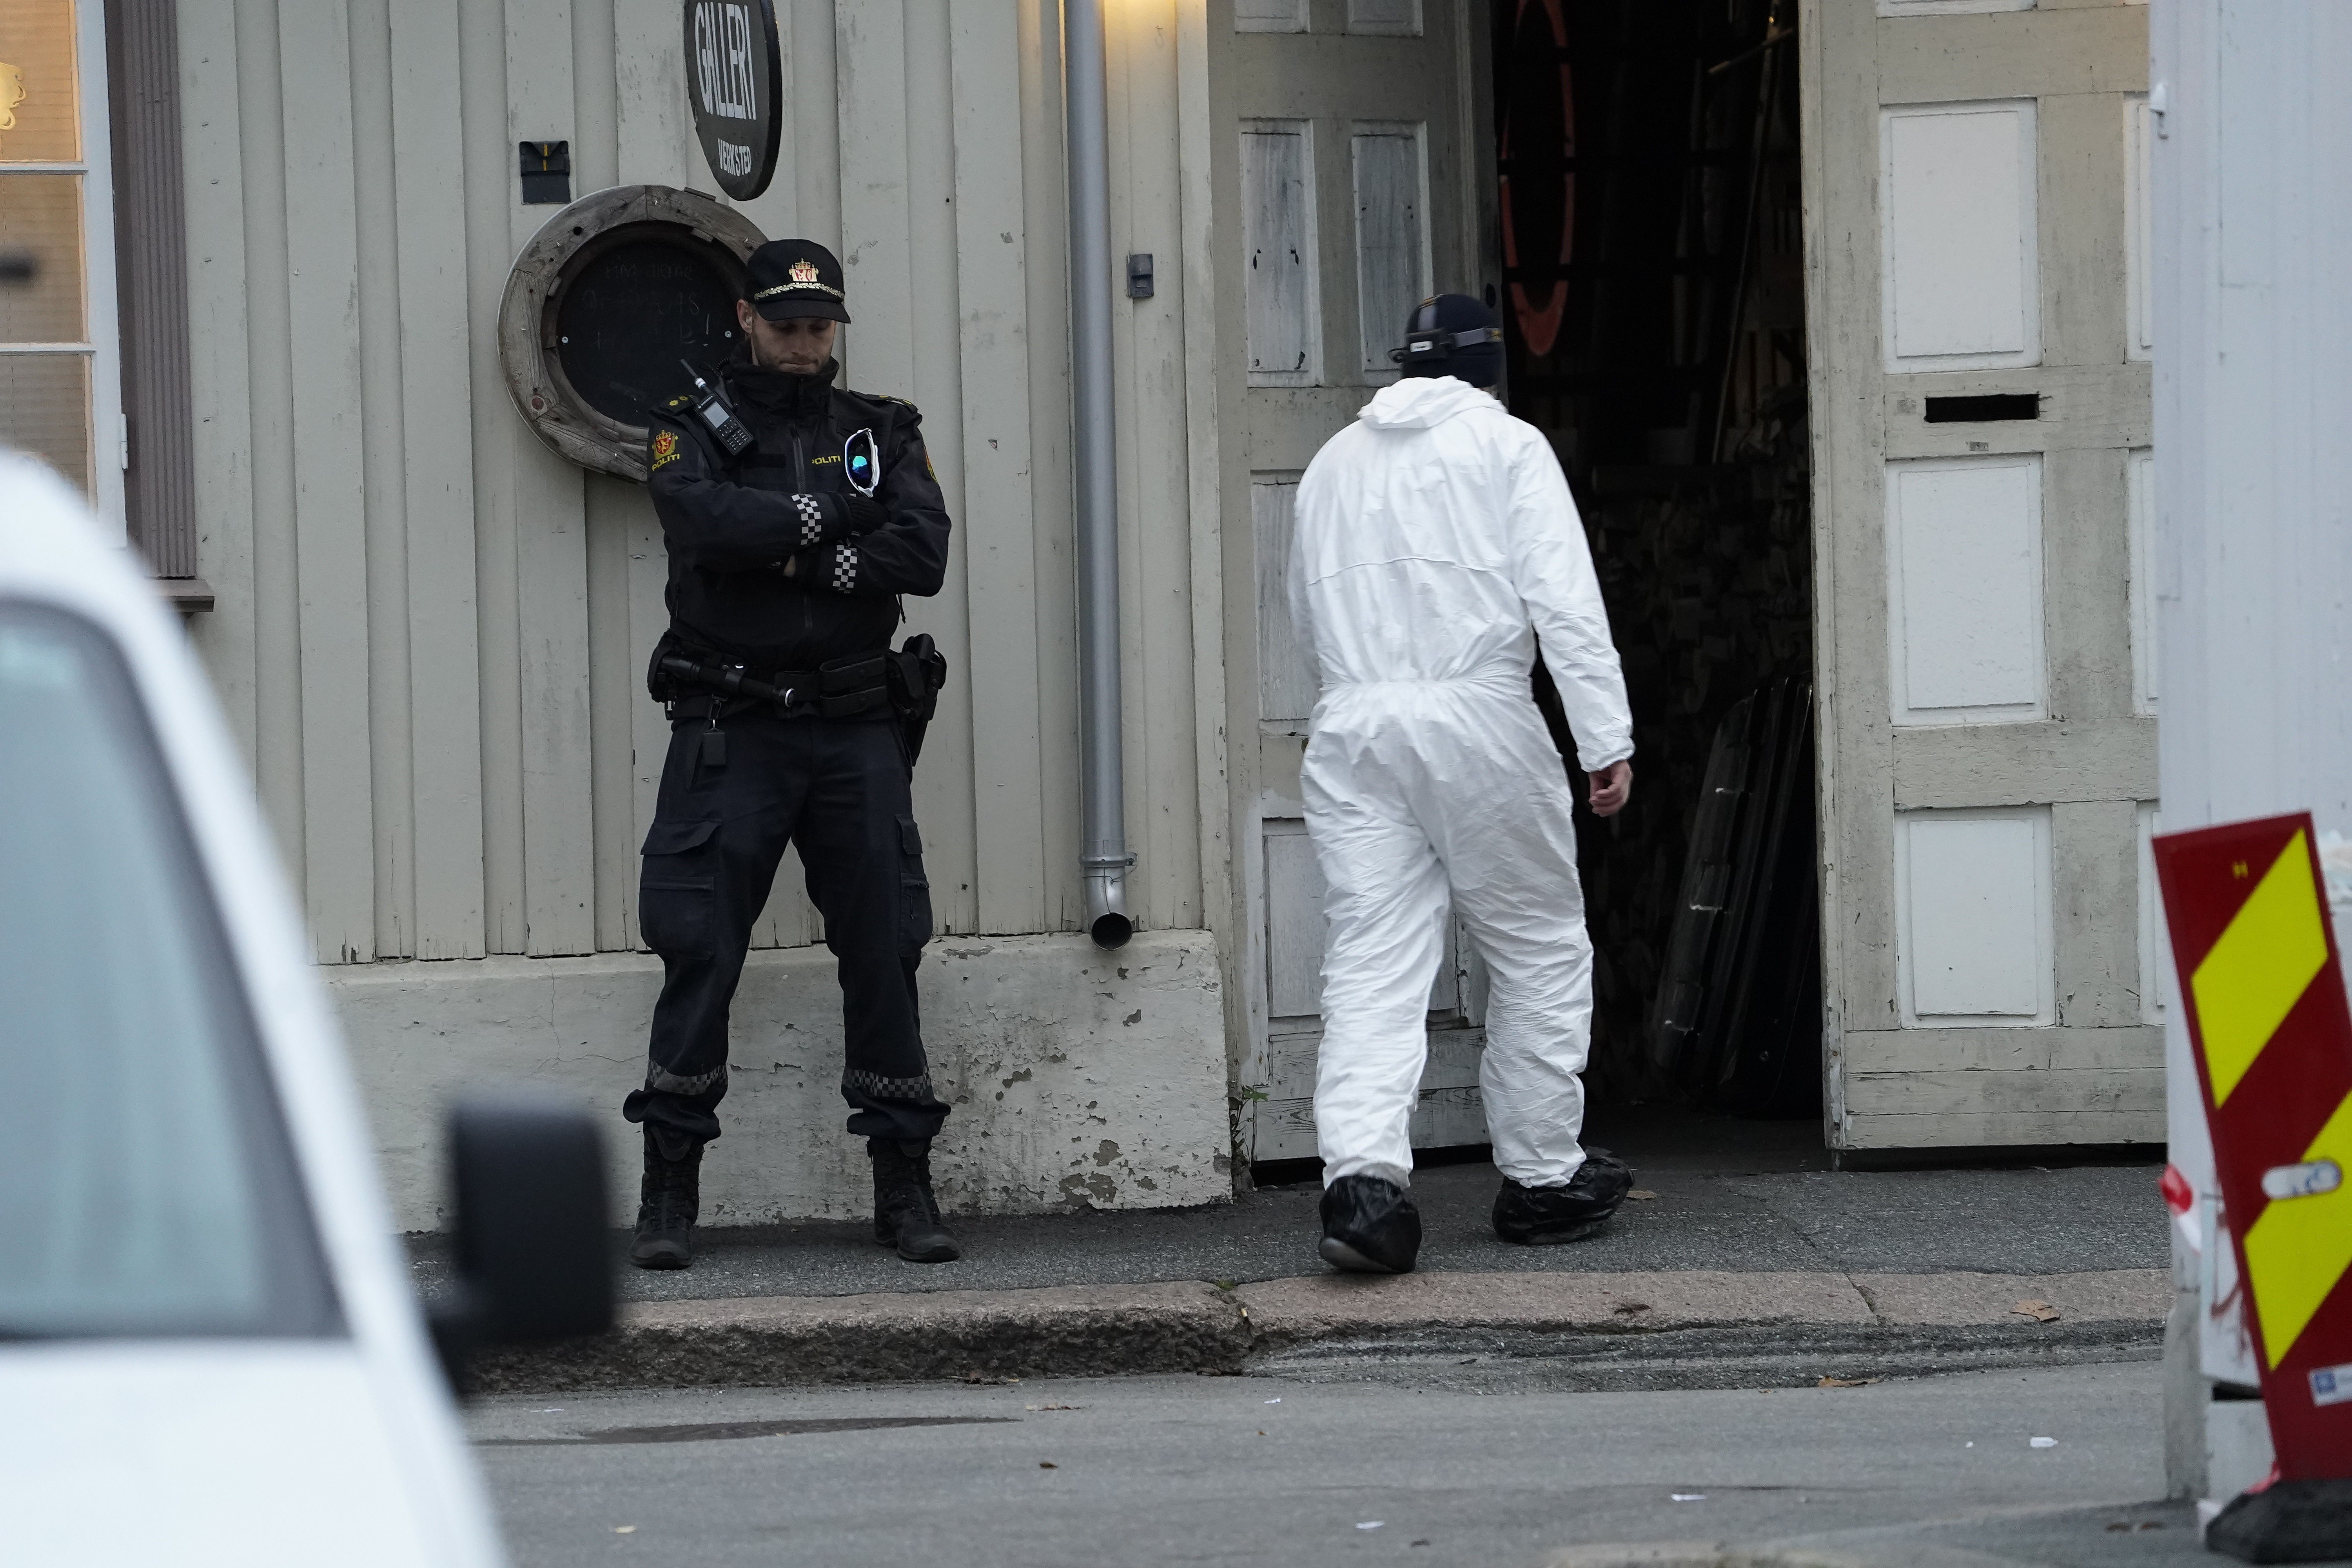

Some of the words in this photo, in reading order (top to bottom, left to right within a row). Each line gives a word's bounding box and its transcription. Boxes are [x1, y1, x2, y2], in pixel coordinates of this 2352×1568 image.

[695, 2, 757, 120] GALLERI
[718, 138, 751, 176] VERKSTED
[652, 454, 680, 471] POLITI
